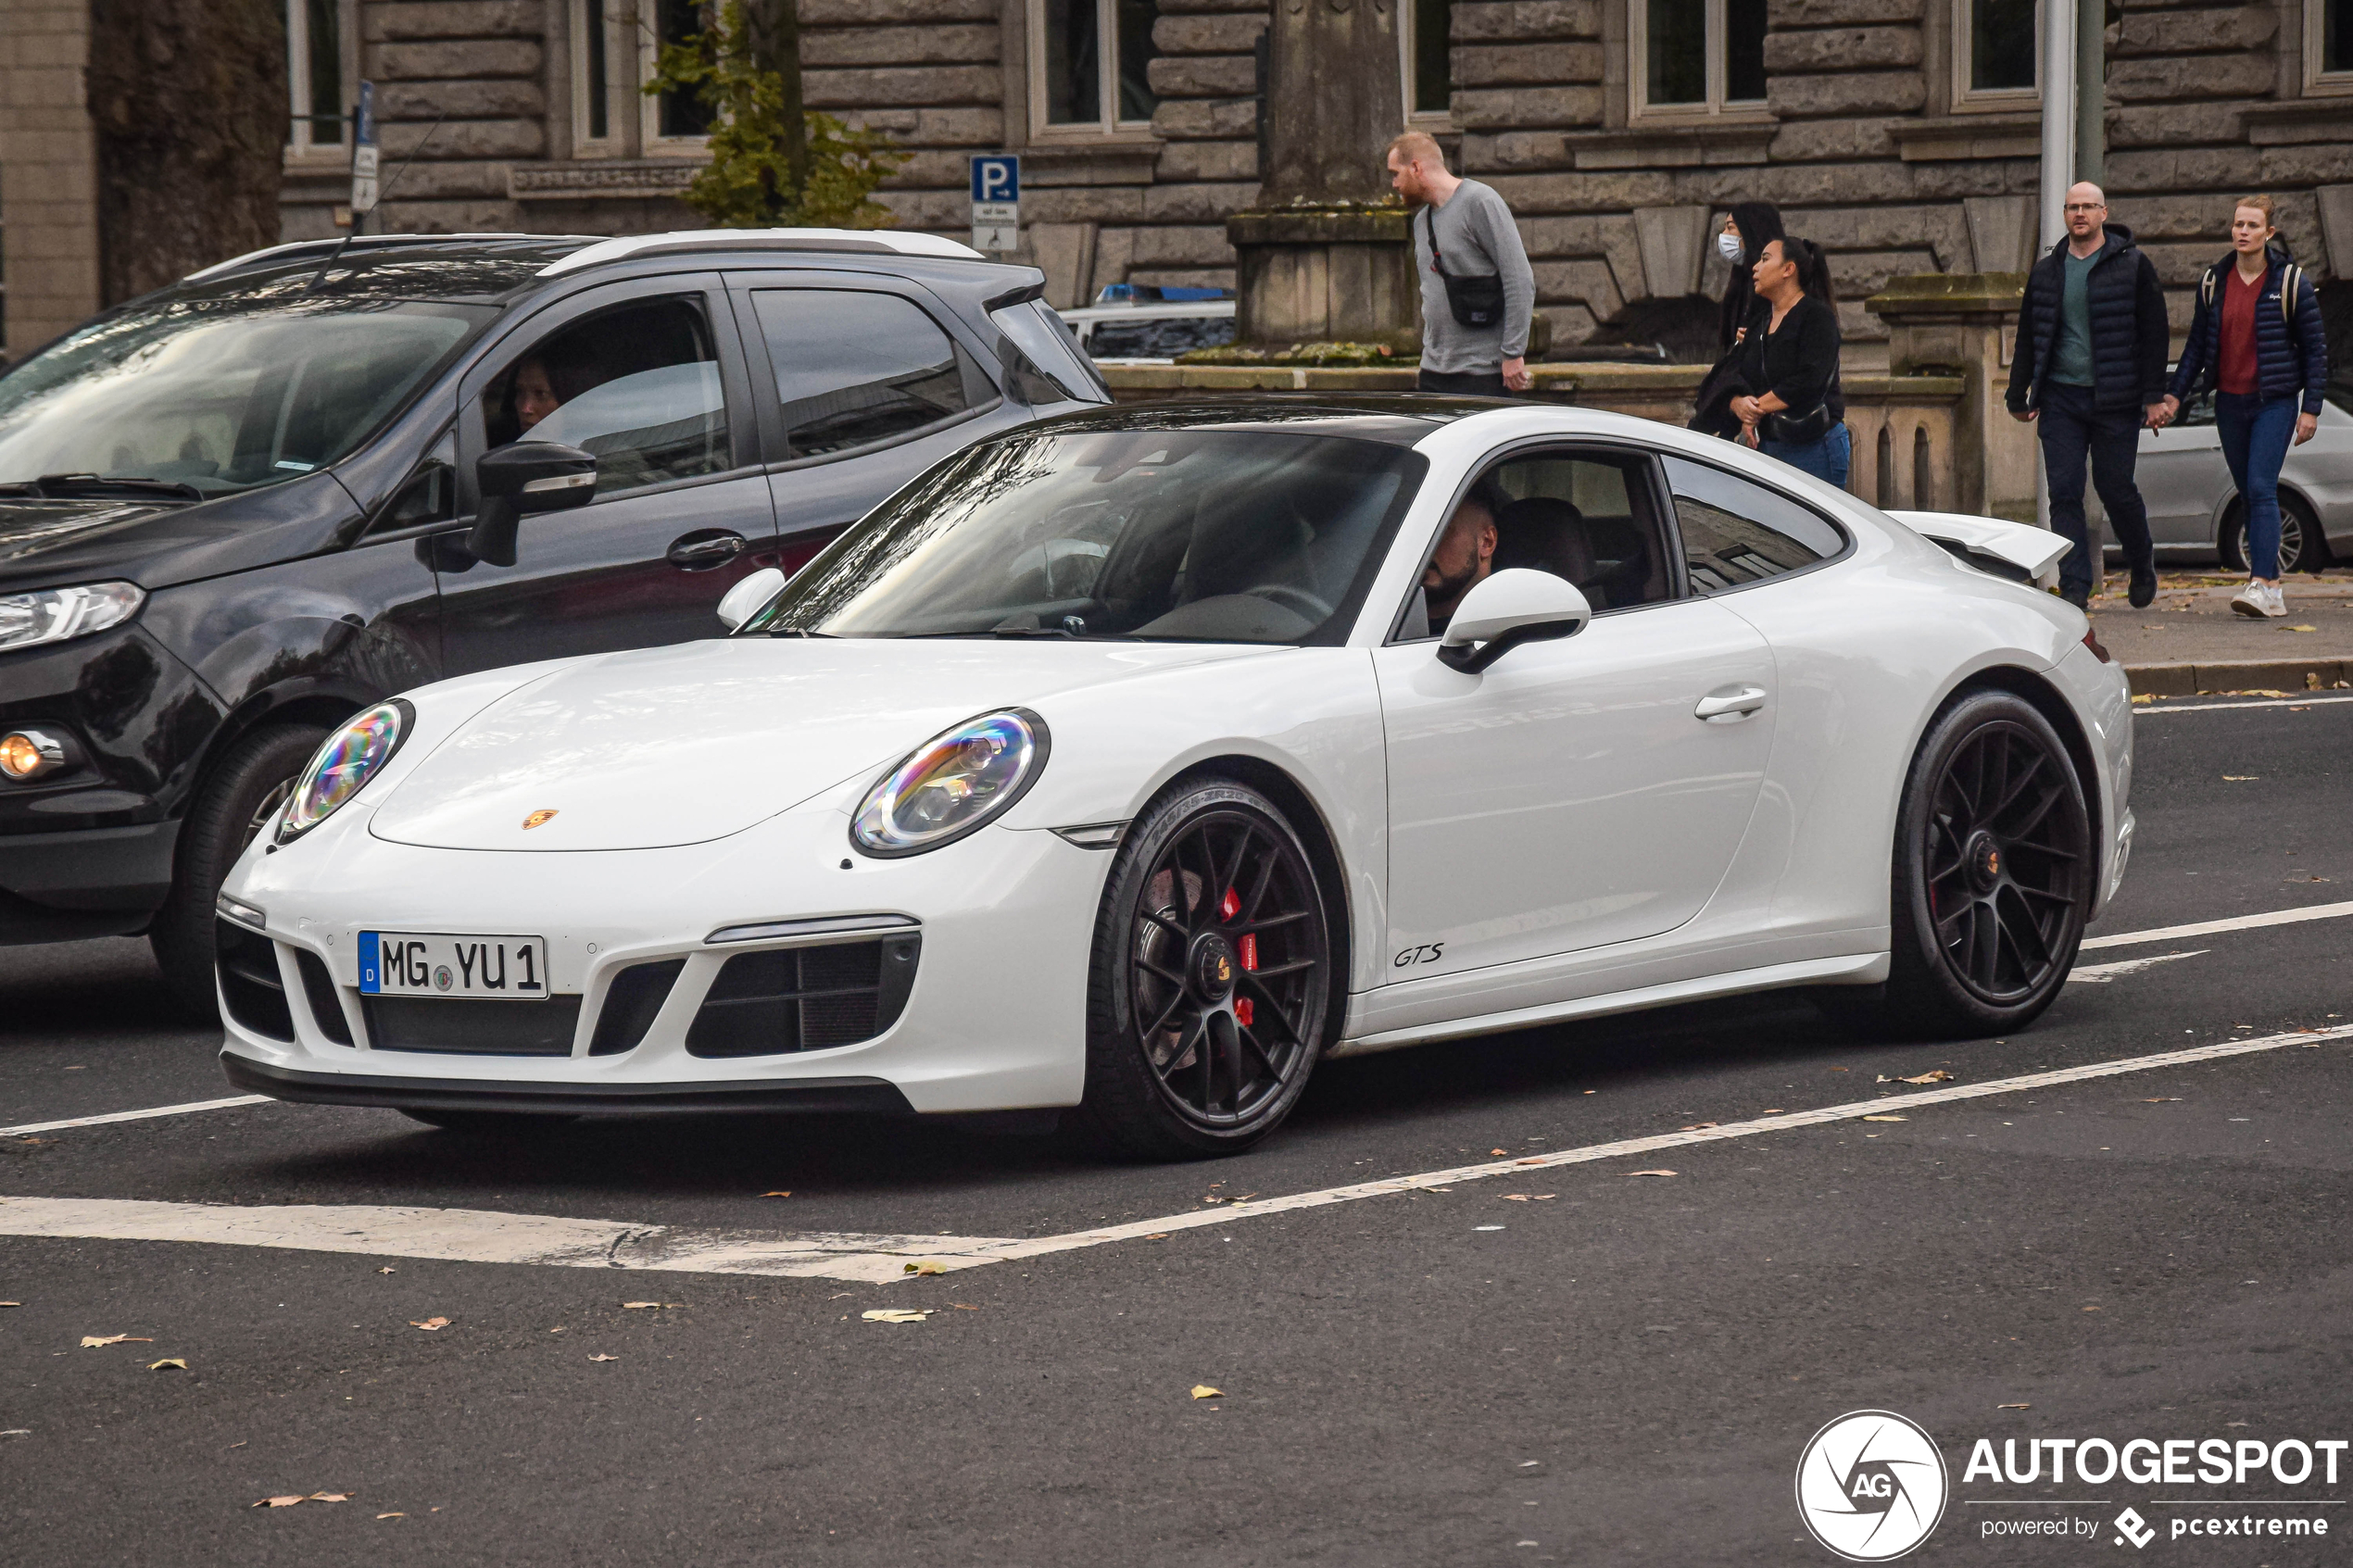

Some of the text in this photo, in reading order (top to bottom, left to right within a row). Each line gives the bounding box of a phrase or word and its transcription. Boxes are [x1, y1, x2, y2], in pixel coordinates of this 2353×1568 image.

[982, 162, 1008, 200] P
[382, 940, 542, 990] MG YU 1
[1394, 942, 1445, 968] GTS
[366, 969, 374, 982] D
